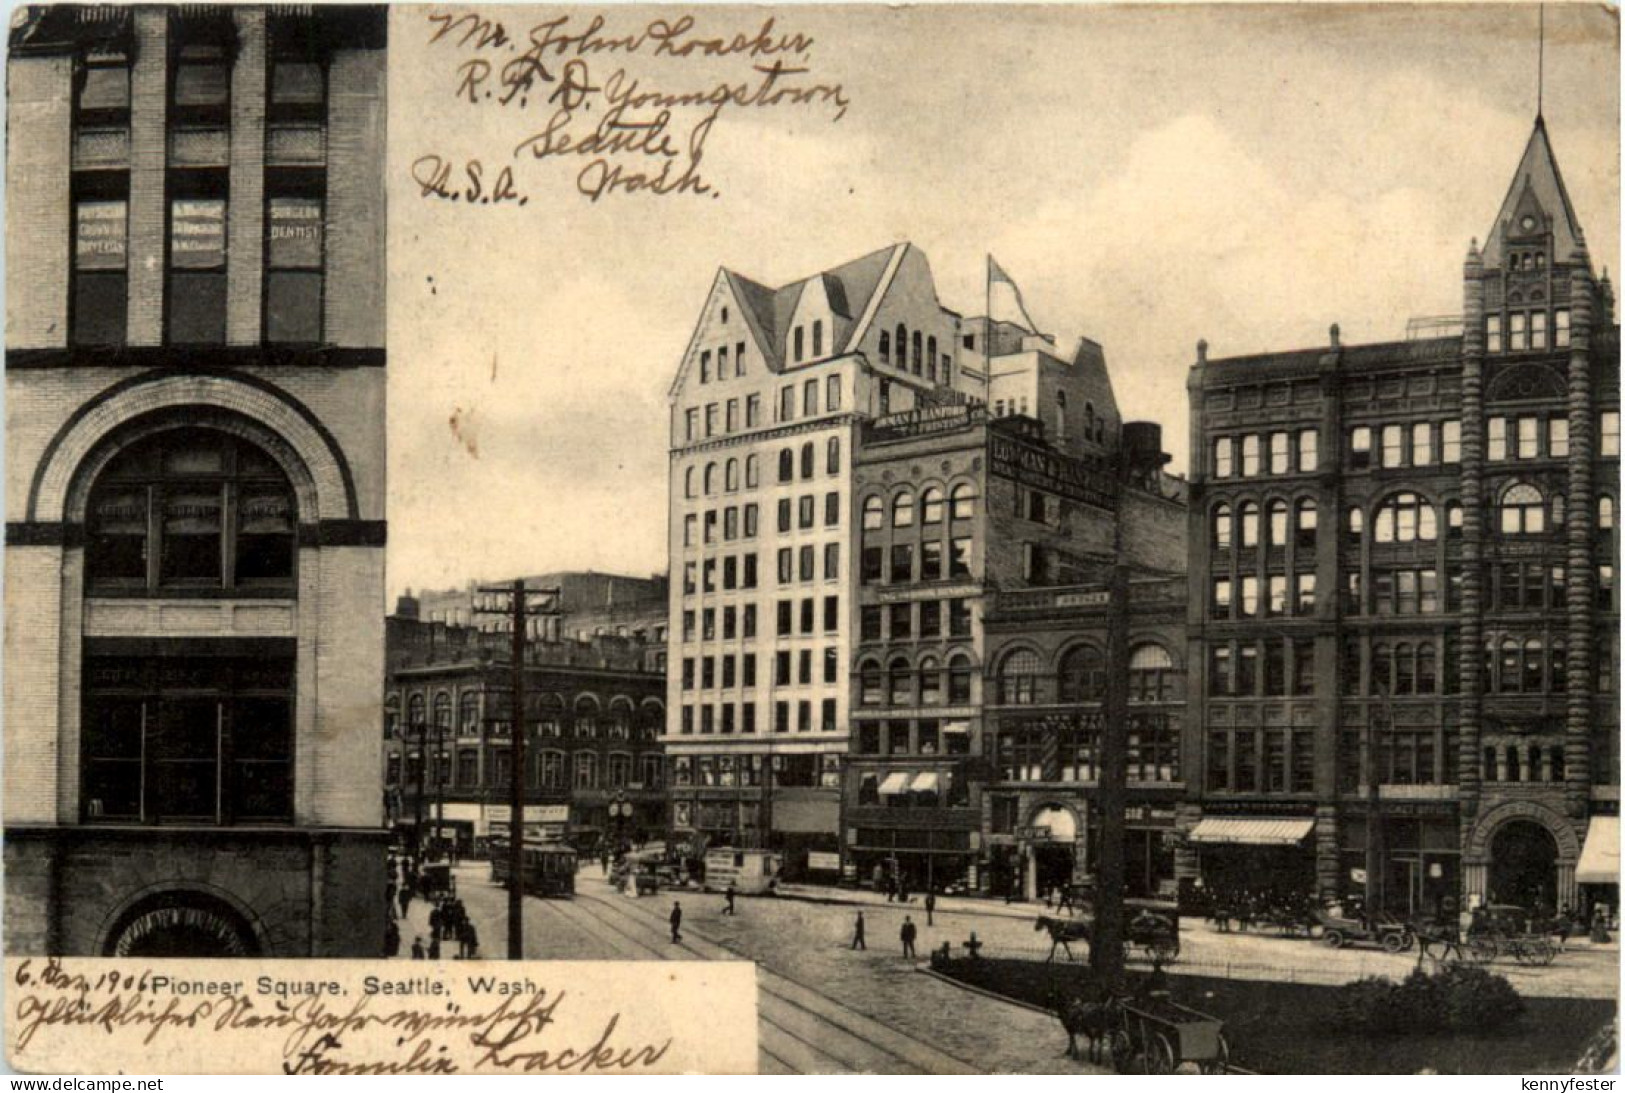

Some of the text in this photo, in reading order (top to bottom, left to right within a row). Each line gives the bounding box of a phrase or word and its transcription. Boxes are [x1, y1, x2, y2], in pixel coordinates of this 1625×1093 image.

[428, 13, 515, 51] Mr.
[527, 15, 647, 62] John
[456, 59, 491, 104] R.
[515, 109, 680, 159] Seattle
[577, 157, 720, 201] Wash.
[271, 224, 318, 240] DENTIST
[15, 958, 38, 988] 6.
